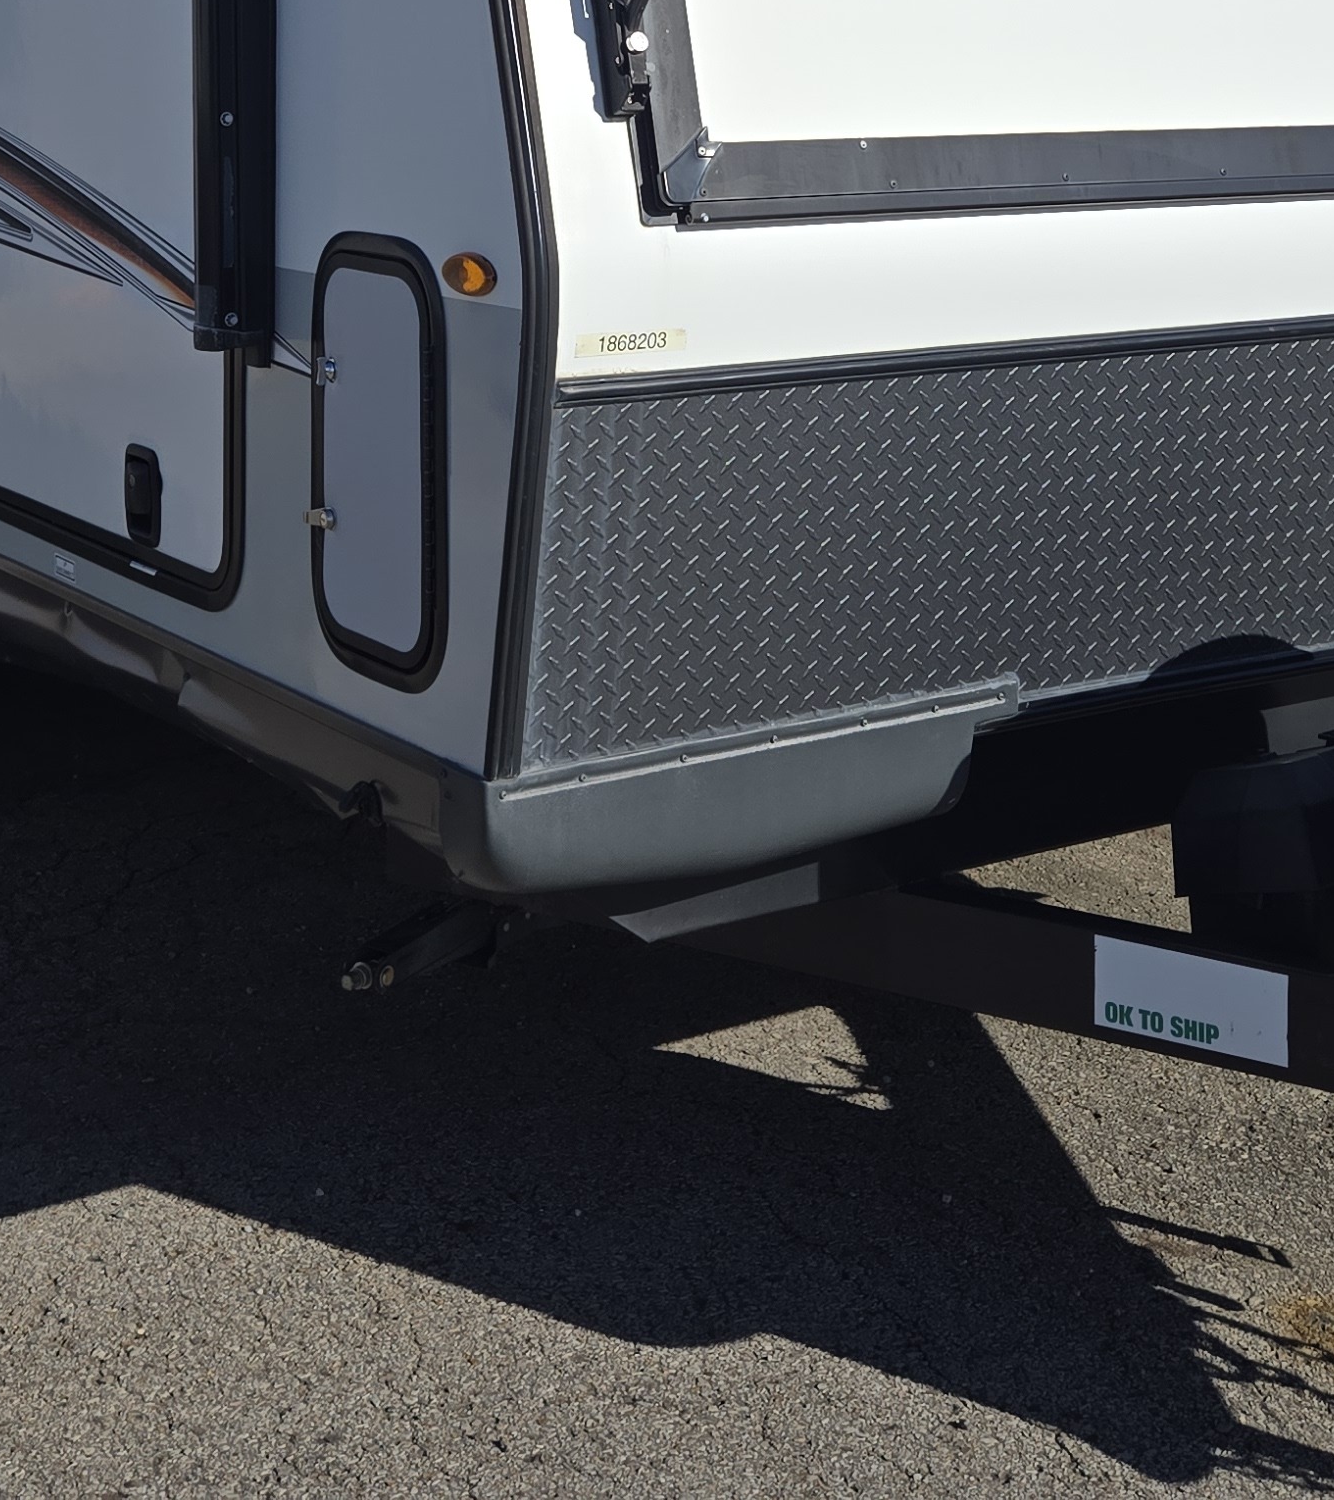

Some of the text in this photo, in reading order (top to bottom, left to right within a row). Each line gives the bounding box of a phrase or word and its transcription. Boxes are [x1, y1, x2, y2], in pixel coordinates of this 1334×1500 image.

[598, 332, 667, 353] 1868203
[1105, 1001, 1220, 1044] OK TO SHIP
